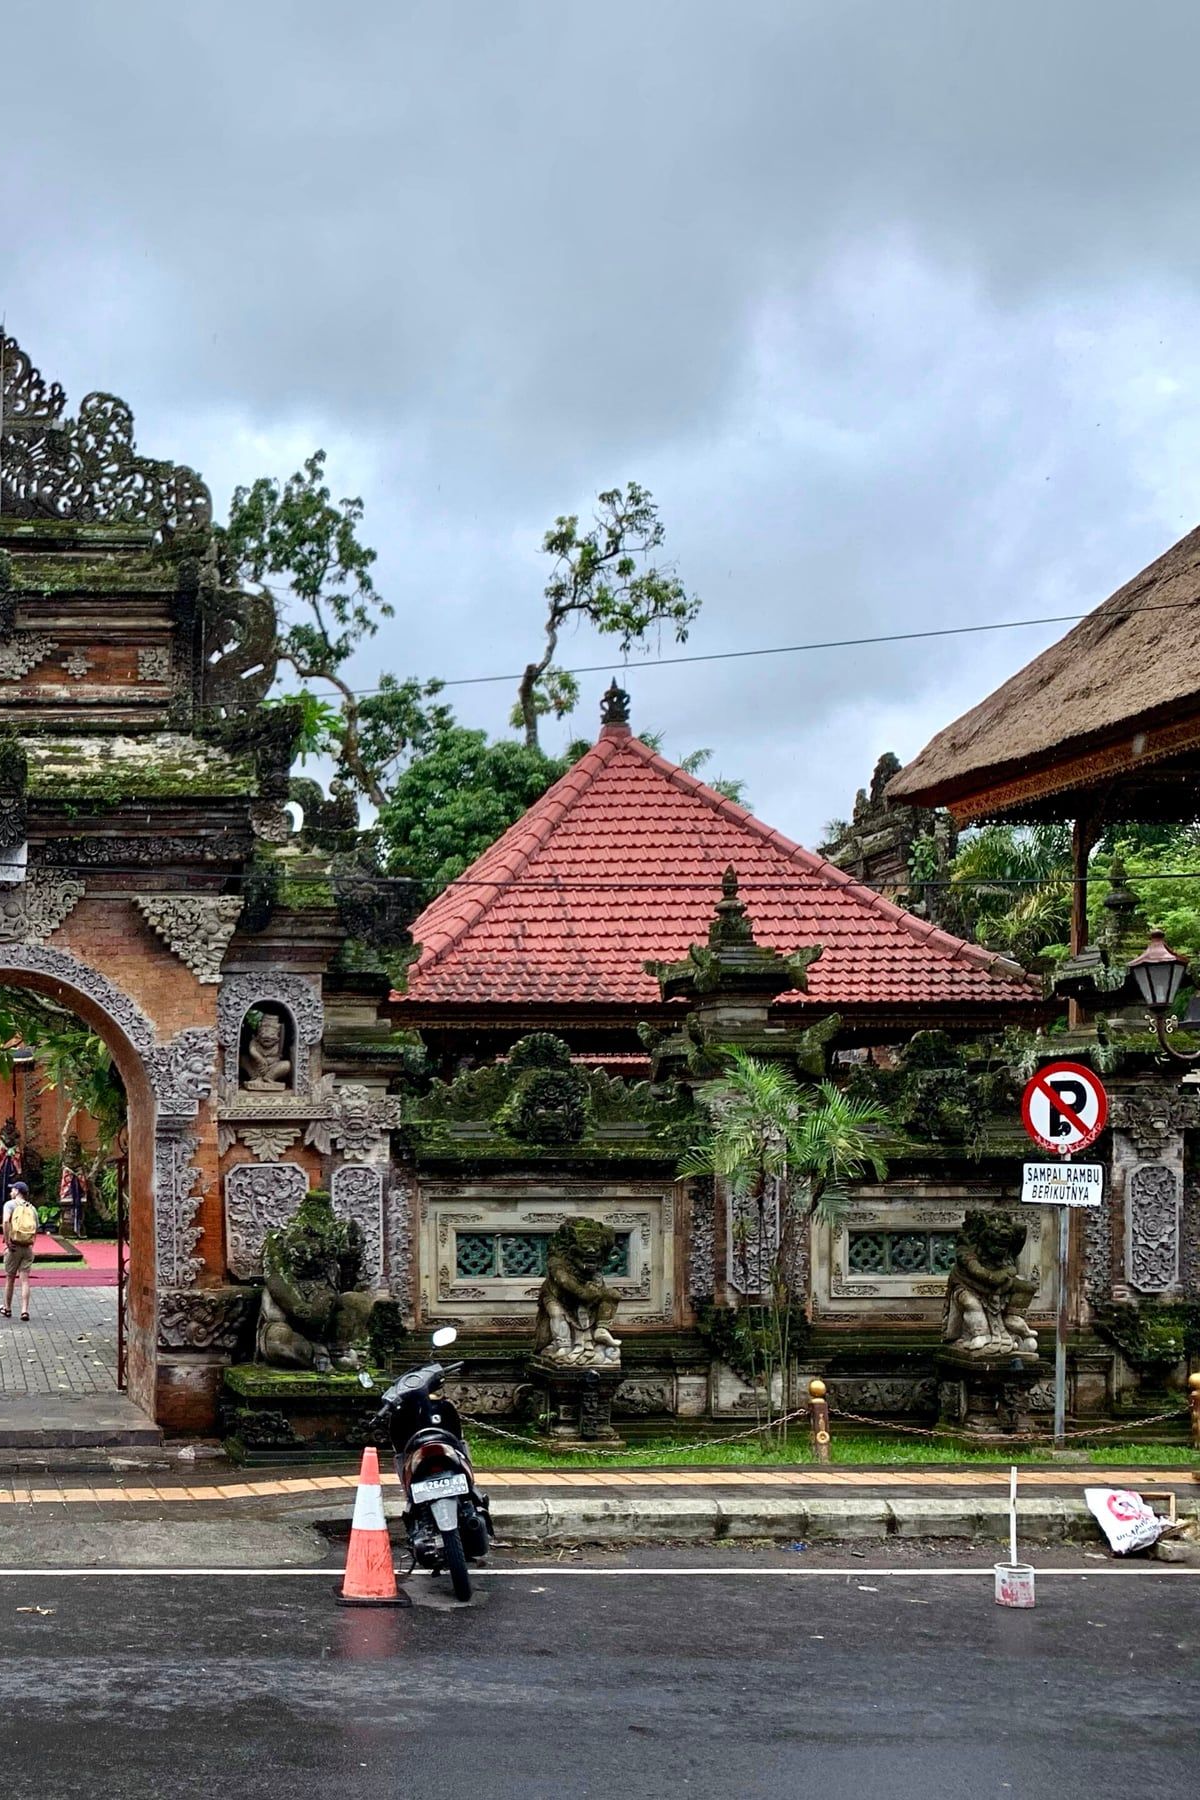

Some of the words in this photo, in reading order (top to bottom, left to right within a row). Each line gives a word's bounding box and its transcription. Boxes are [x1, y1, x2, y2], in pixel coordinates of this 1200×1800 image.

[1027, 1167, 1061, 1182] SAMPAI
[1066, 1168, 1099, 1183] RAMBU
[1031, 1185, 1089, 1200] BERIKUTNYA
[428, 1479, 450, 1490] 2649
